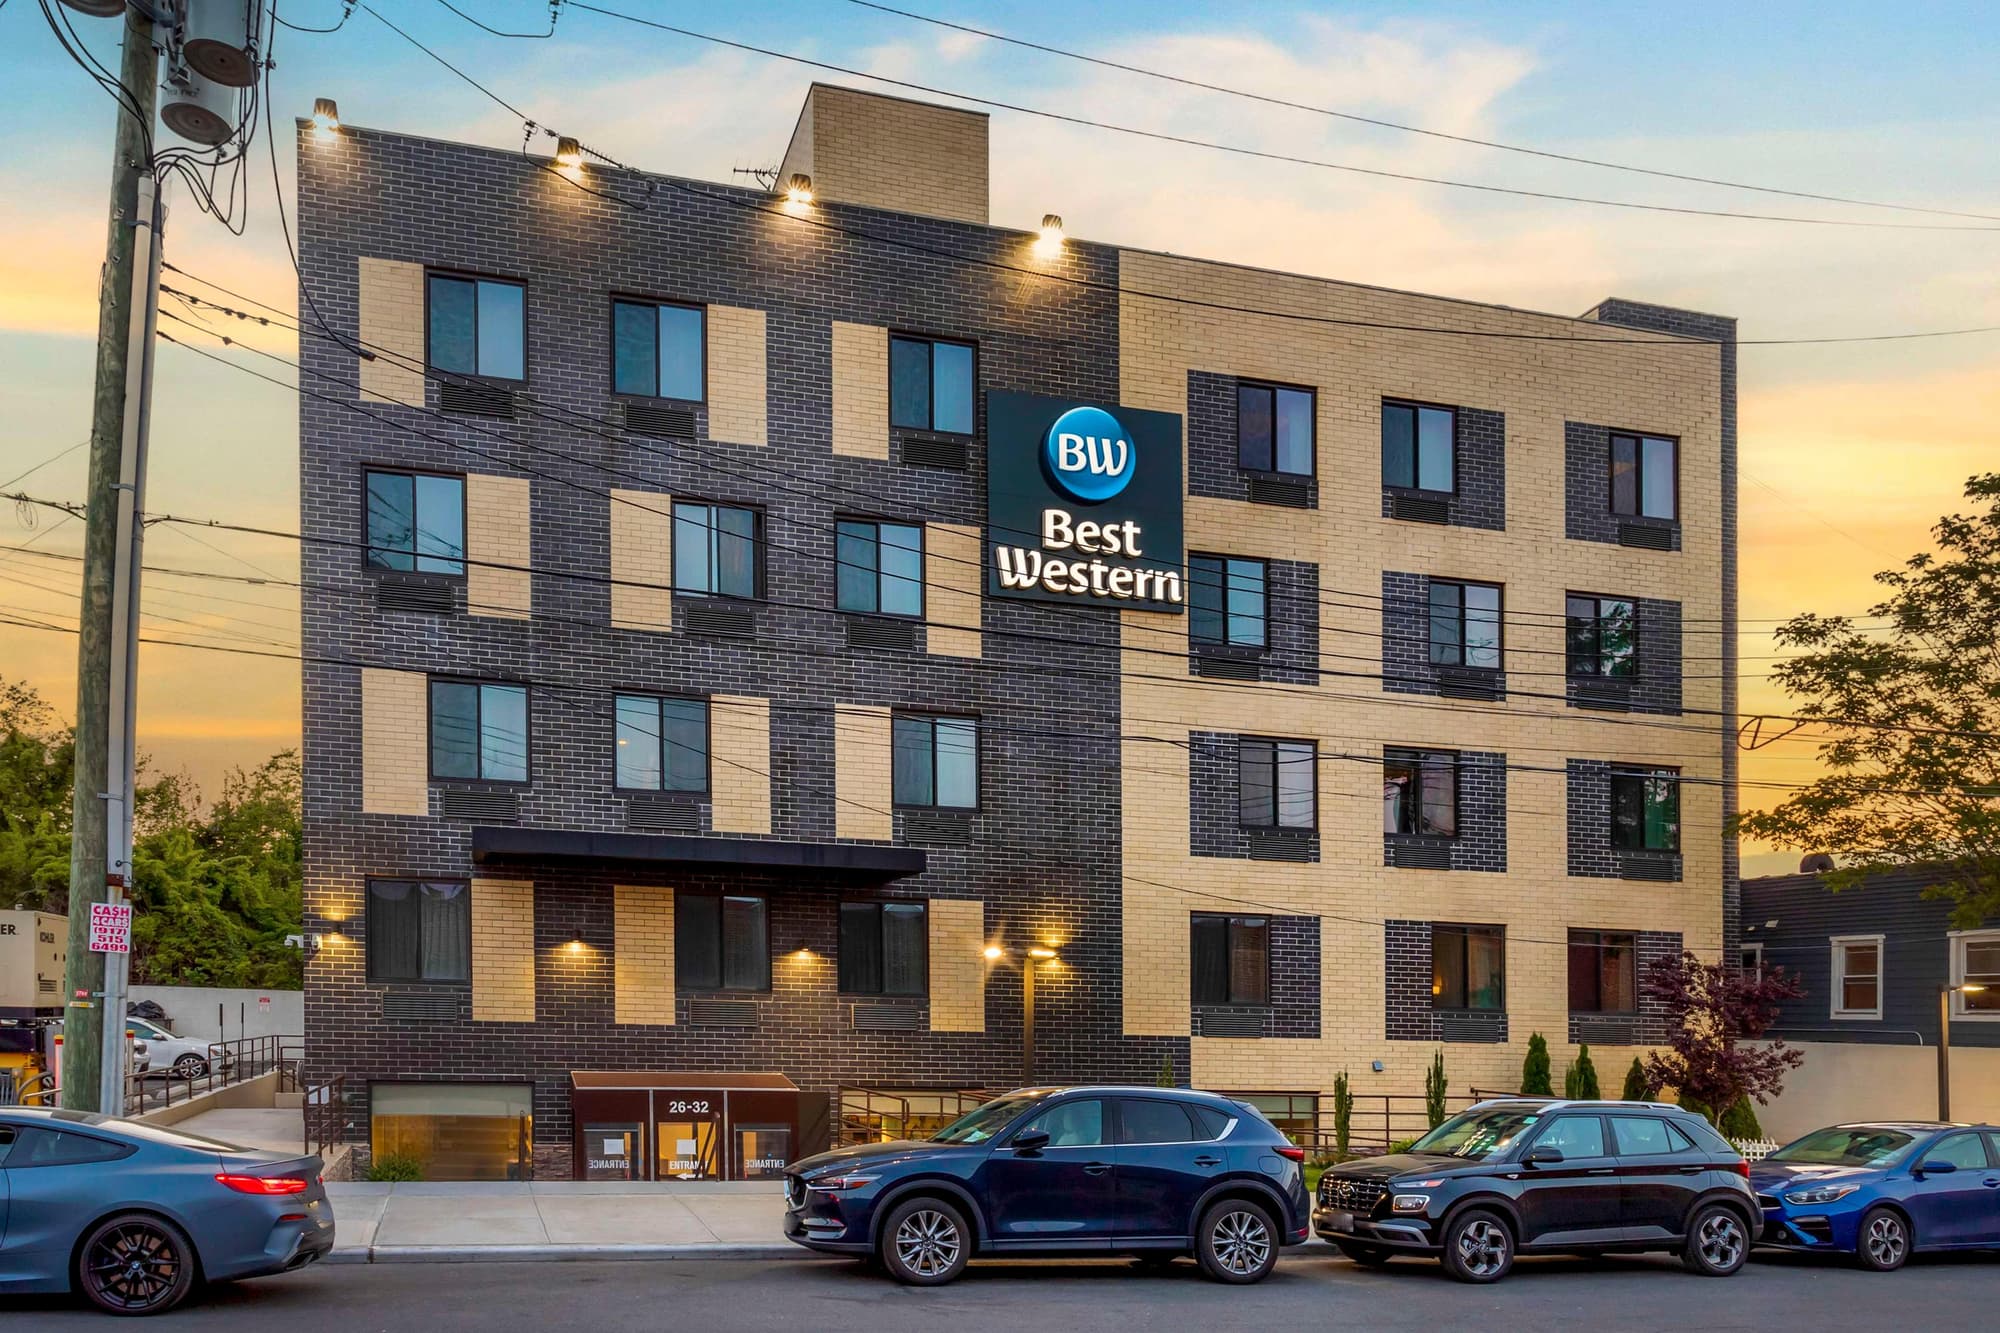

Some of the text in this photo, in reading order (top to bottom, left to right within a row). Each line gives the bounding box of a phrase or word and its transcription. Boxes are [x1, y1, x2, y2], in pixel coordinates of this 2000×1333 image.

[1058, 433, 1128, 476] BW
[1042, 509, 1142, 557] Best
[996, 546, 1184, 602] Western
[94, 927, 127, 935] (917)
[97, 935, 124, 943] 515
[91, 942, 128, 952] 6499
[669, 1101, 709, 1113] 26-32
[669, 1160, 709, 1170] ENTRAN
